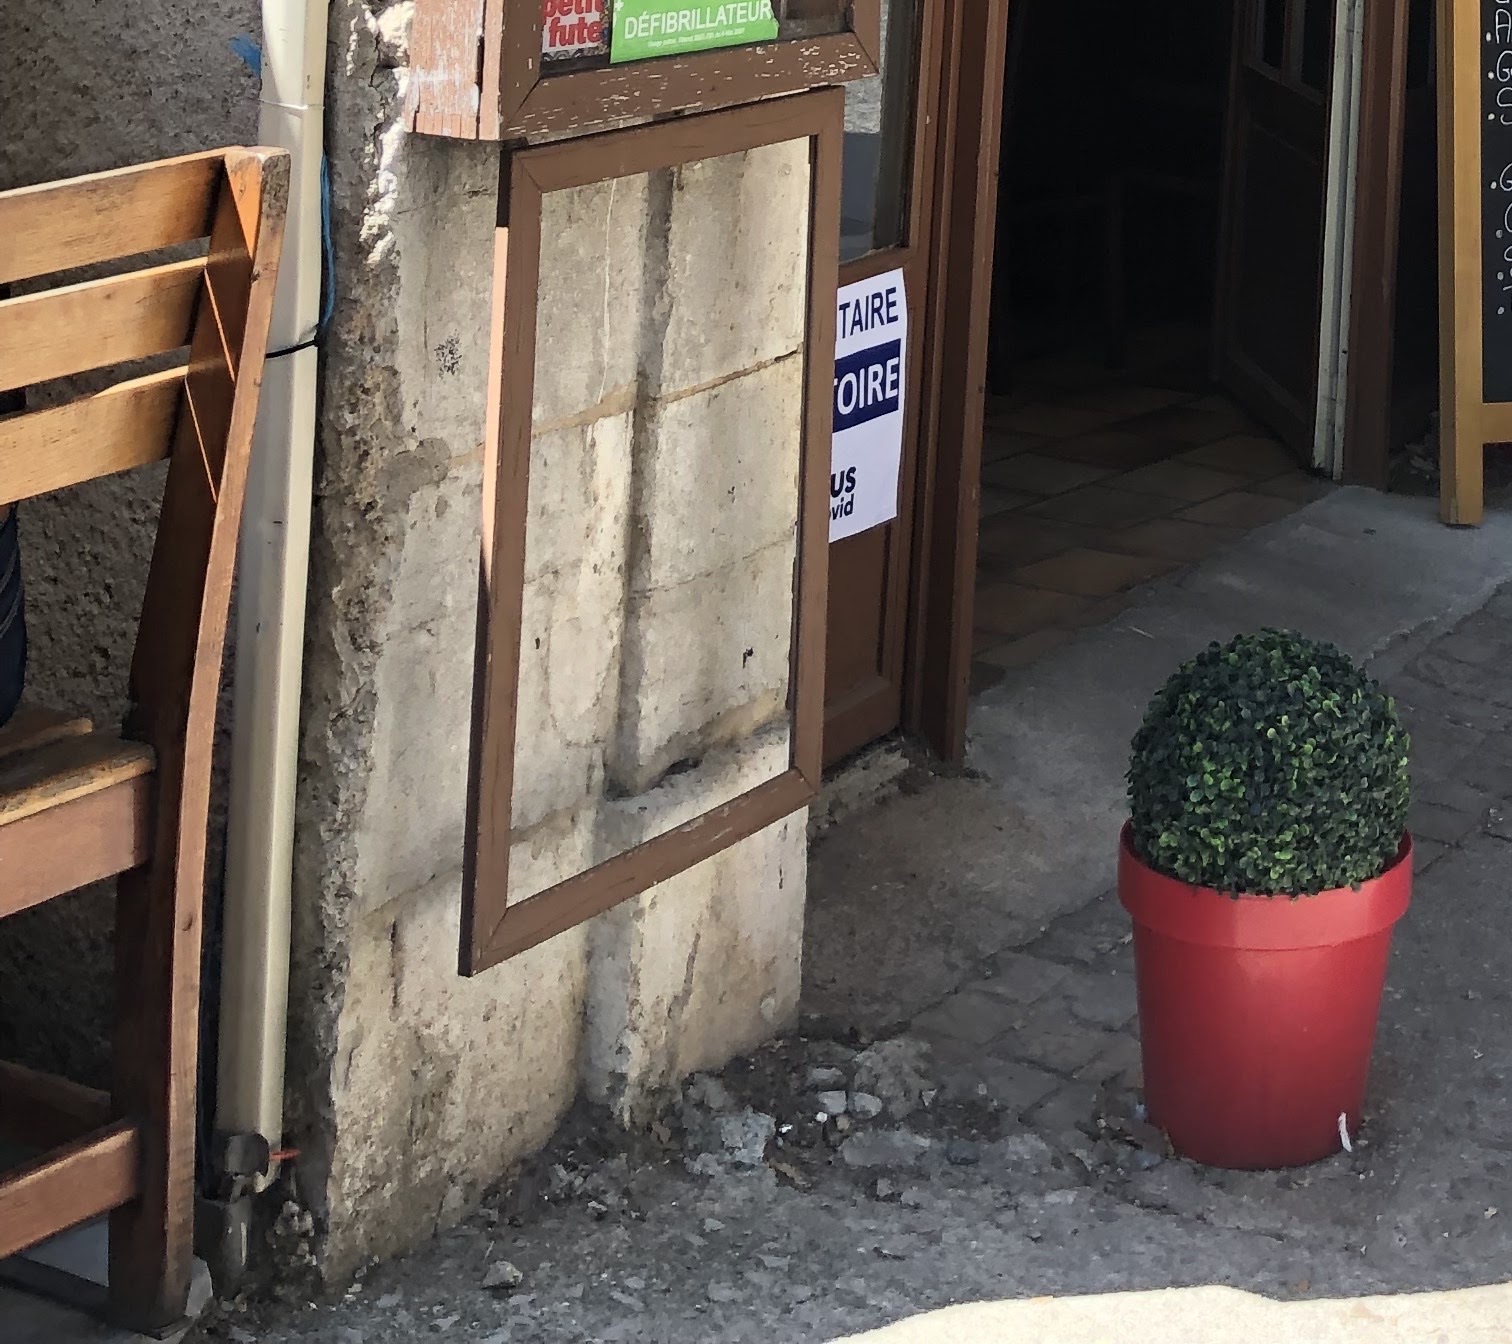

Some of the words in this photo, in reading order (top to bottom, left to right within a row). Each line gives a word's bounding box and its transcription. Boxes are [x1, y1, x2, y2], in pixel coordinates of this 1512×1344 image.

[624, 0, 772, 40] DÉFIBRILLATEUR
[838, 286, 899, 339] TAIRE
[833, 356, 899, 415] OIRE
